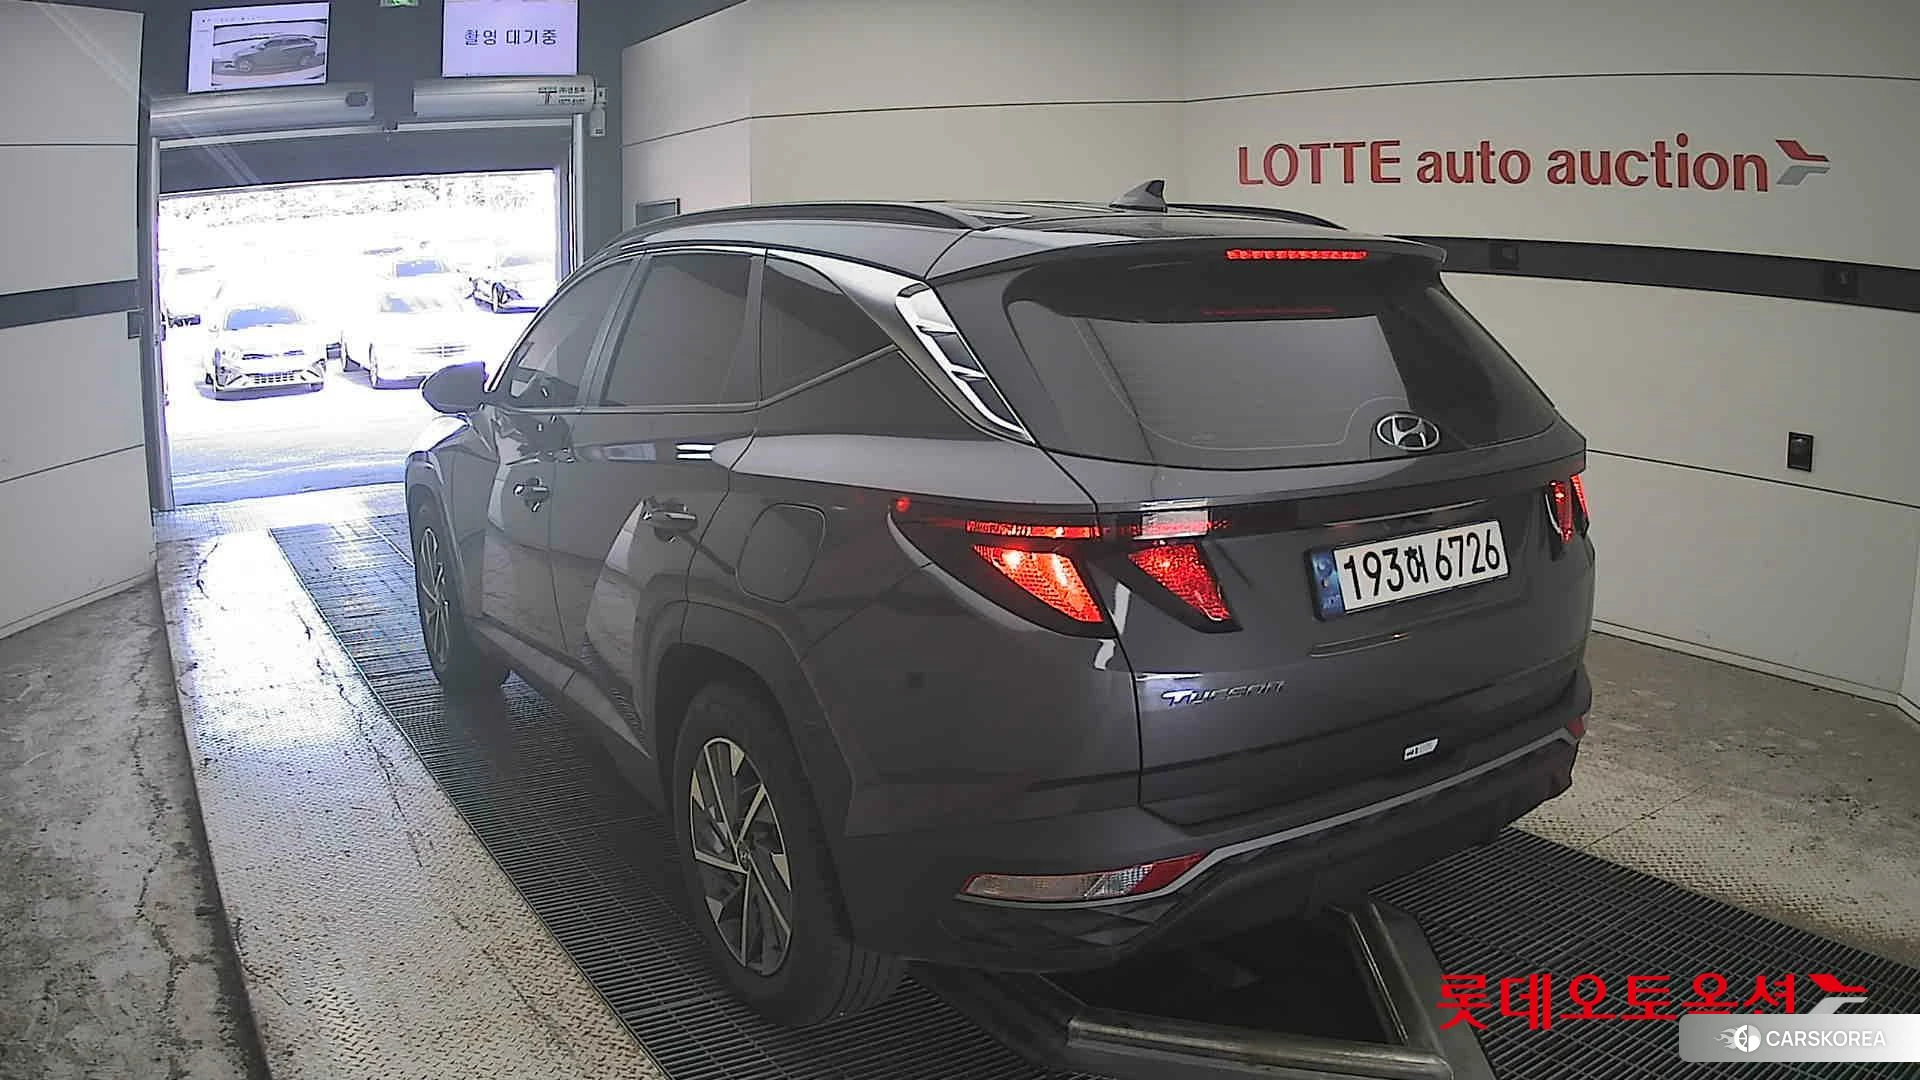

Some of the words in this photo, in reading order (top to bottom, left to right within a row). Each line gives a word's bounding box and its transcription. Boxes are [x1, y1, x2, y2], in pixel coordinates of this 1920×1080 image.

[506, 29, 558, 46] 대기중
[1239, 140, 1401, 187] LOTTE
[1416, 140, 1531, 184] auto
[1547, 133, 1768, 192] auction
[1436, 529, 1501, 581] 6726
